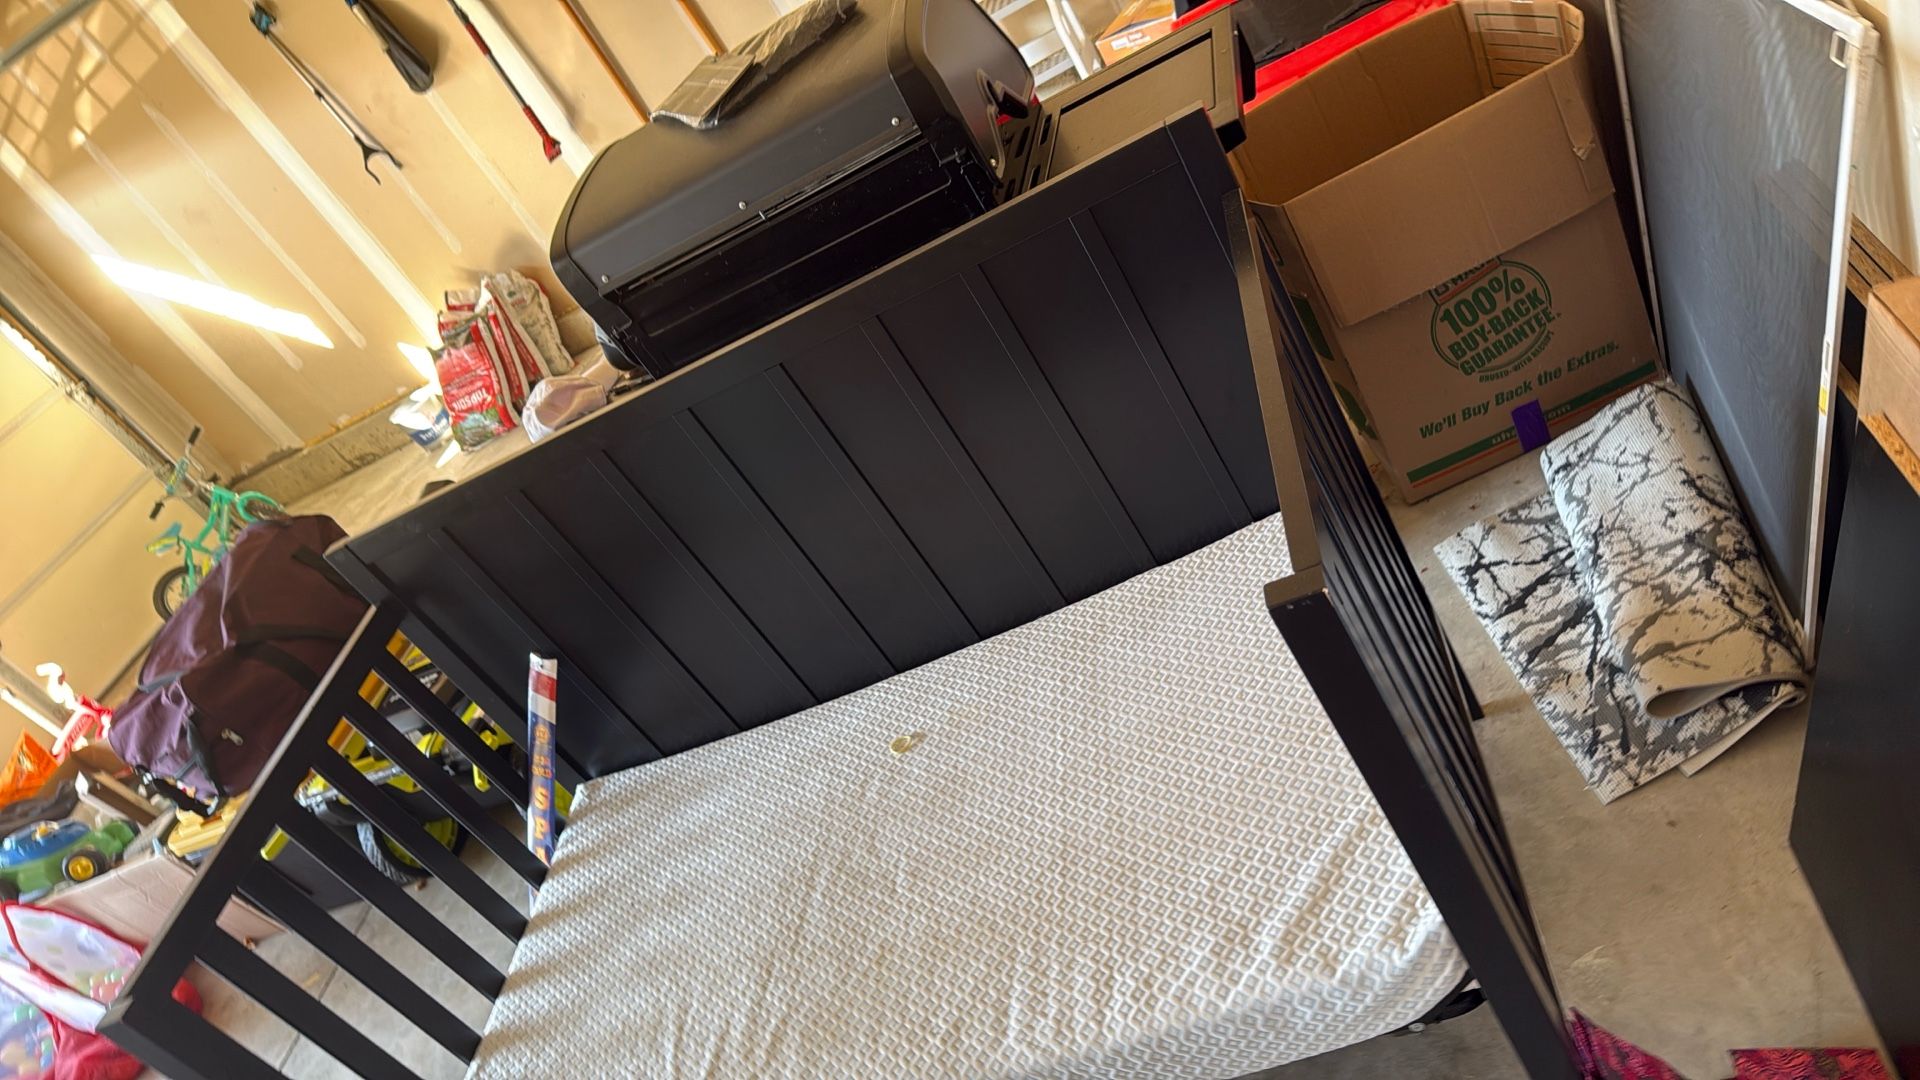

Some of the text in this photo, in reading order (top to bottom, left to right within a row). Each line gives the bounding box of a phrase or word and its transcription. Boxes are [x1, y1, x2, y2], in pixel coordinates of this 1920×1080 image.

[1440, 268, 1526, 335] 100%
[1447, 287, 1545, 361] BUY-BACK
[1419, 341, 1619, 439] We'll Buy Back the Extras.
